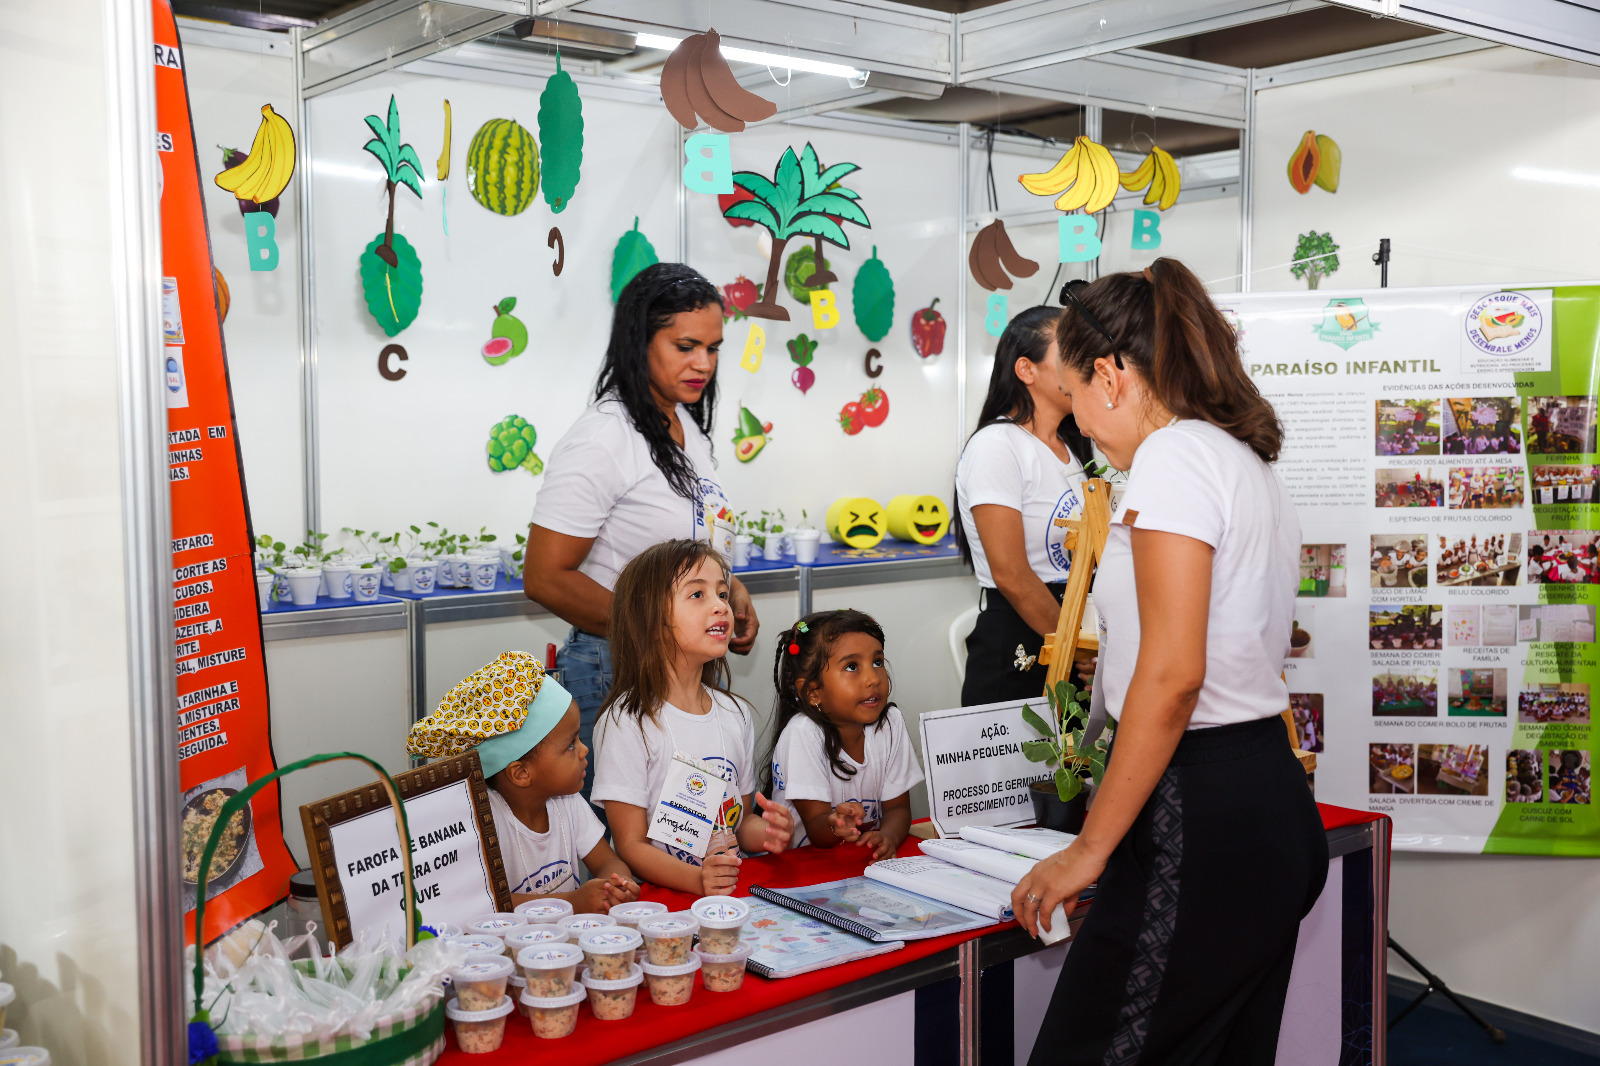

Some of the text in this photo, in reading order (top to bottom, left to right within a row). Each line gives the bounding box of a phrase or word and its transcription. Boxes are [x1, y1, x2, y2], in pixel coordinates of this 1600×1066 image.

[1058, 214, 1102, 263] B
[1131, 209, 1161, 250] B
[244, 212, 279, 271] B
[810, 290, 840, 330] B
[1470, 296, 1538, 320] DESCASQUE MAIS
[740, 323, 766, 374] B
[1470, 328, 1537, 353] DESEMBALE MENOS
[378, 344, 408, 381] C
[865, 348, 884, 378] C
[1250, 359, 1441, 377] PARAÍSO INFANTIL
[1444, 382, 1470, 390] AÇÕES
[1472, 381, 1534, 389] DESENVOLVIDAS
[208, 427, 226, 438] EM
[1533, 506, 1583, 514] DEGUSTAÇÃO
[176, 559, 226, 580] CORTE AS
[176, 582, 212, 599] CUBOS.
[1406, 586, 1427, 594] LIMÃO
[1538, 592, 1588, 600] OBSERVAÇÃO
[174, 603, 209, 619] IDEIRA
[176, 620, 222, 640] AZEITE, A
[1473, 654, 1500, 662] FAMÍLIA
[1530, 643, 1581, 651] VALORIZAÇÃO
[176, 648, 245, 675] SAL, MISTURE
[183, 684, 227, 707] FARINHA
[230, 681, 238, 692] E
[185, 698, 239, 724] MISTURAR
[179, 721, 220, 742] IENTES.
[981, 723, 1009, 740] AÇÃO:
[1526, 732, 1576, 740] DEGUSTAÇÃO
[179, 735, 227, 759] SEGUIDA.
[936, 751, 971, 765] MINHA
[973, 743, 1019, 759] PEQUENA
[943, 784, 989, 801] PROCESSO
[992, 781, 1003, 793] DE
[670, 801, 706, 819] EXPOSITOR
[948, 794, 1029, 817] E CRESCIMENTO DA
[348, 848, 399, 877] FAROFA
[419, 821, 466, 849] BANANA
[372, 879, 390, 896] DA
[434, 849, 458, 870] COM
[400, 883, 441, 911] CUVE
